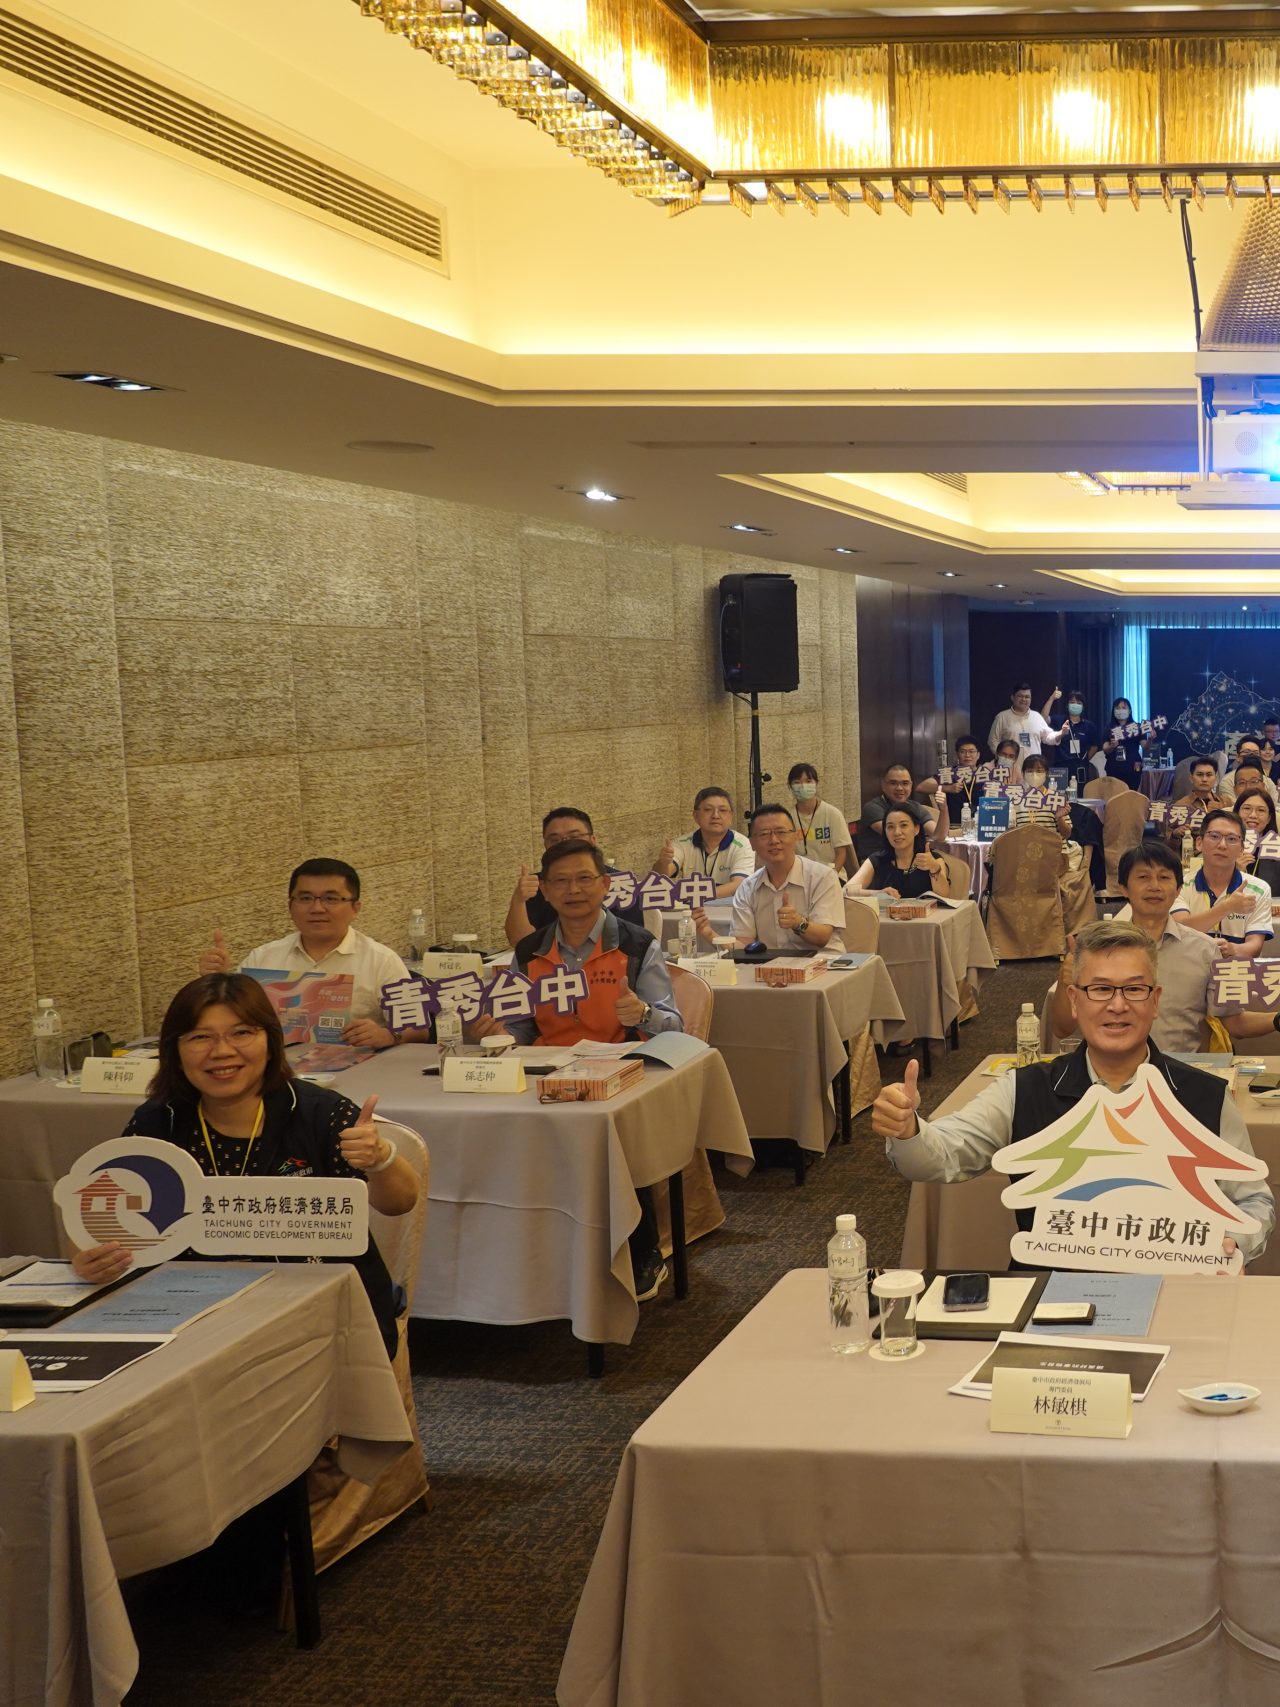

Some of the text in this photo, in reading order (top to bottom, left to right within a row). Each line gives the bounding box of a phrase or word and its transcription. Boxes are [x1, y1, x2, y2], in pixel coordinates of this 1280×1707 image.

[1111, 715, 1167, 740] 青秀台中
[938, 765, 1010, 784] 青秀台中
[384, 967, 585, 1029] 青秀台中
[202, 1195, 354, 1215] 臺中市政府經濟發展局
[205, 1219, 352, 1229] TAICHUNG CITY GOVERNMENT
[1046, 1209, 1211, 1247] 臺中市政府
[205, 1231, 353, 1240] ECONOMIC DEVELOPMENT BUREAU
[1025, 1240, 1233, 1266] TAICHUNG CITY GOVERNMENT
[1033, 1396, 1088, 1417] 林敏棋
